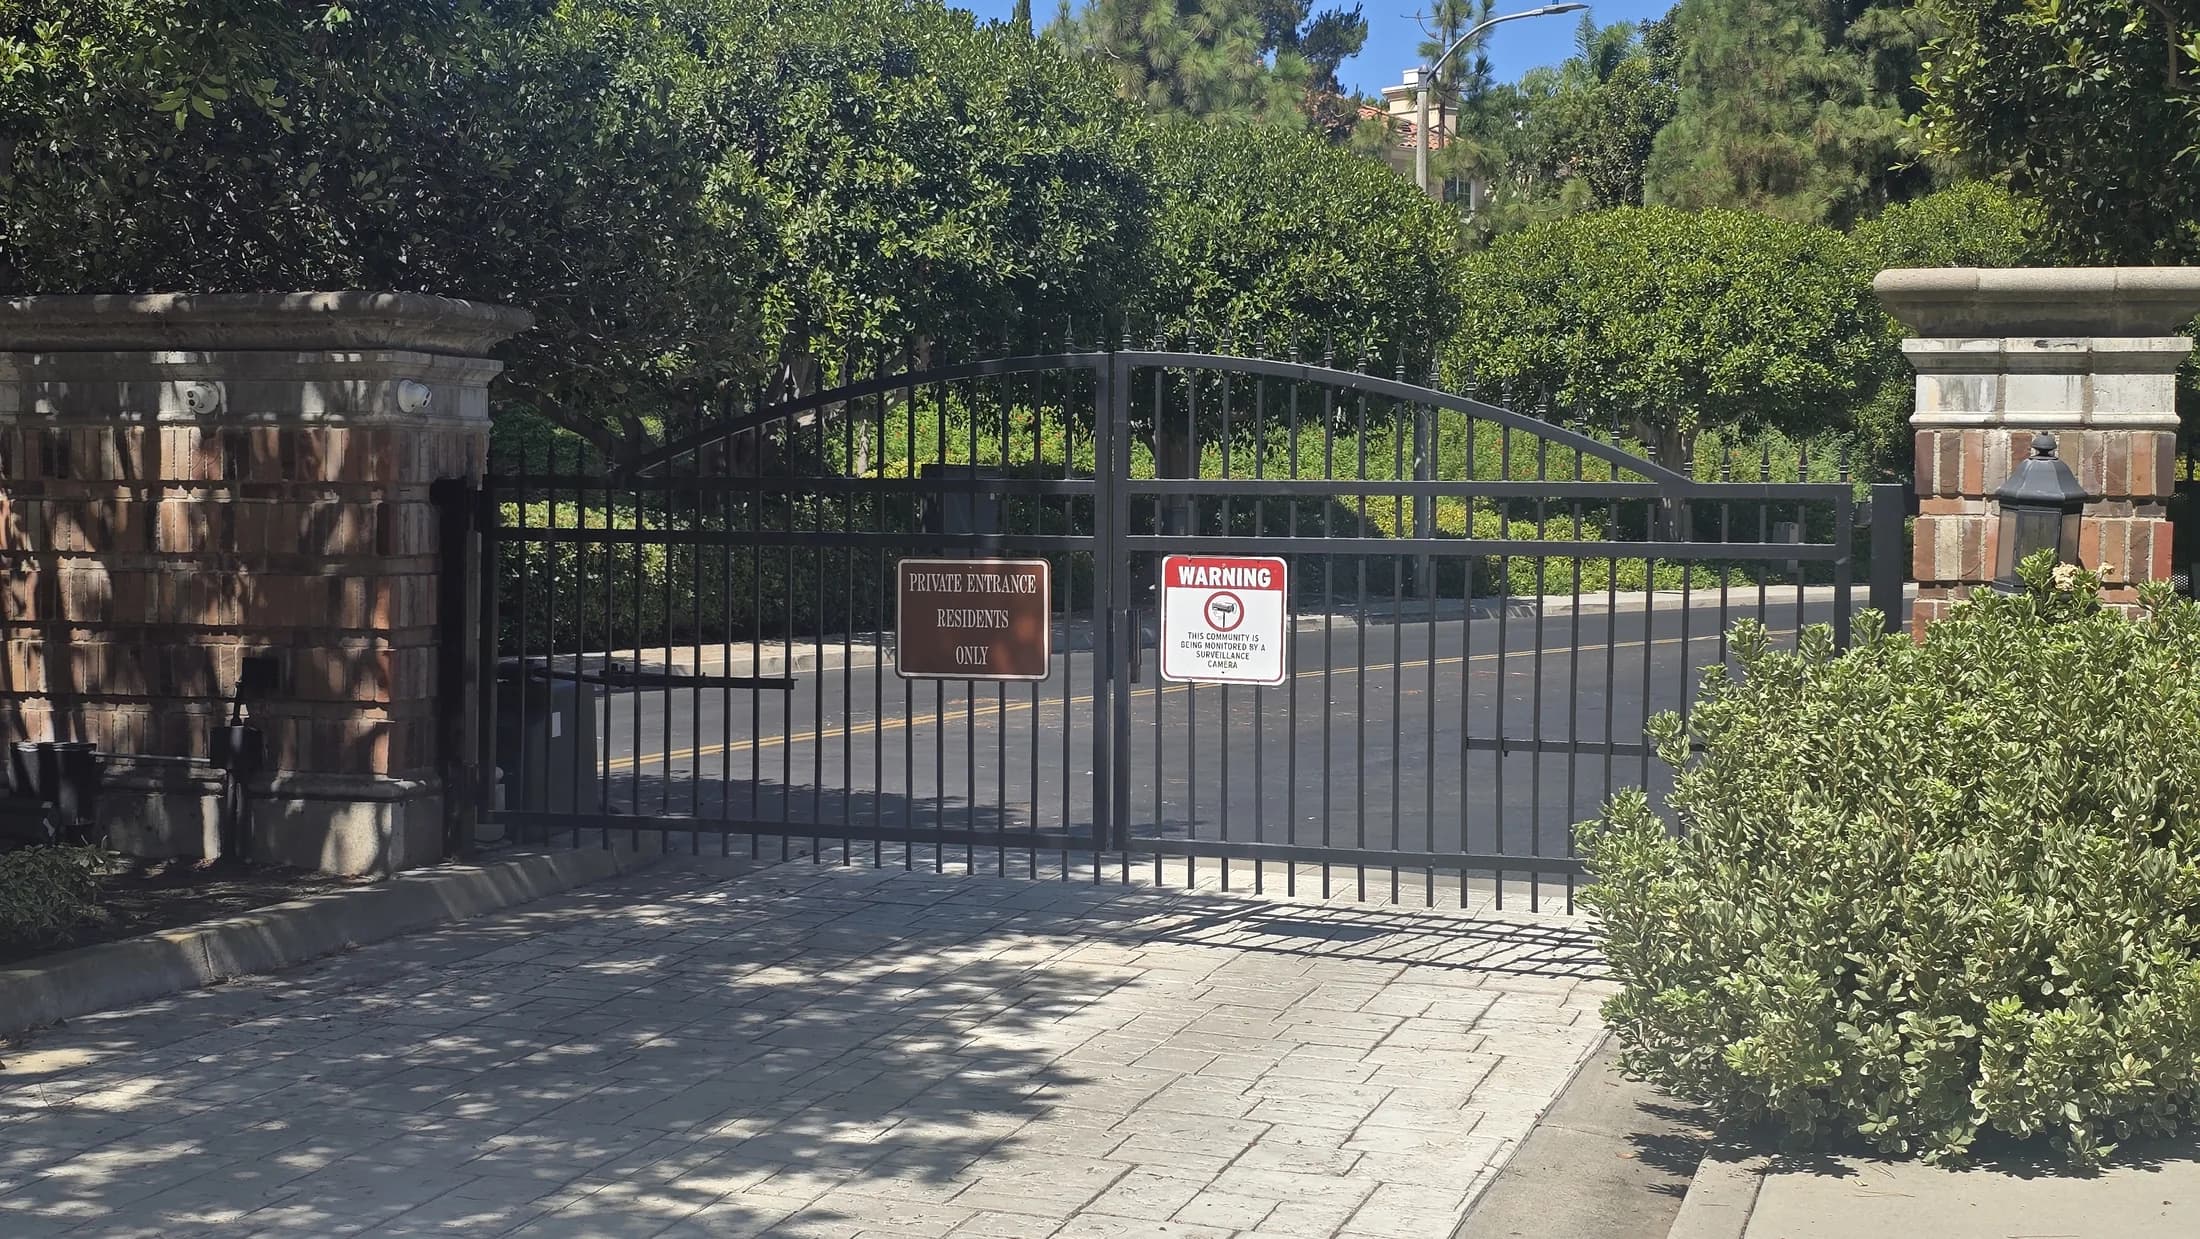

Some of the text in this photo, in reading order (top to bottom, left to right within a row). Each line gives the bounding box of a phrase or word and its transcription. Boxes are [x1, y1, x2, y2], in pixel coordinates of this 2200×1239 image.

[909, 573, 1036, 593] PRIVATE ENTRANCE
[1178, 565, 1271, 588] WARNING
[937, 608, 1009, 628] RESIDENTS
[1188, 632, 1259, 642] THIS COMMUNITY IS
[1180, 641, 1202, 649] BEING
[1205, 642, 1247, 650] MONITORED
[1249, 643, 1258, 651] BY
[955, 646, 989, 665] ONLY
[1196, 650, 1250, 660] SURVEILLANCE
[1208, 660, 1238, 669] CAMERA
